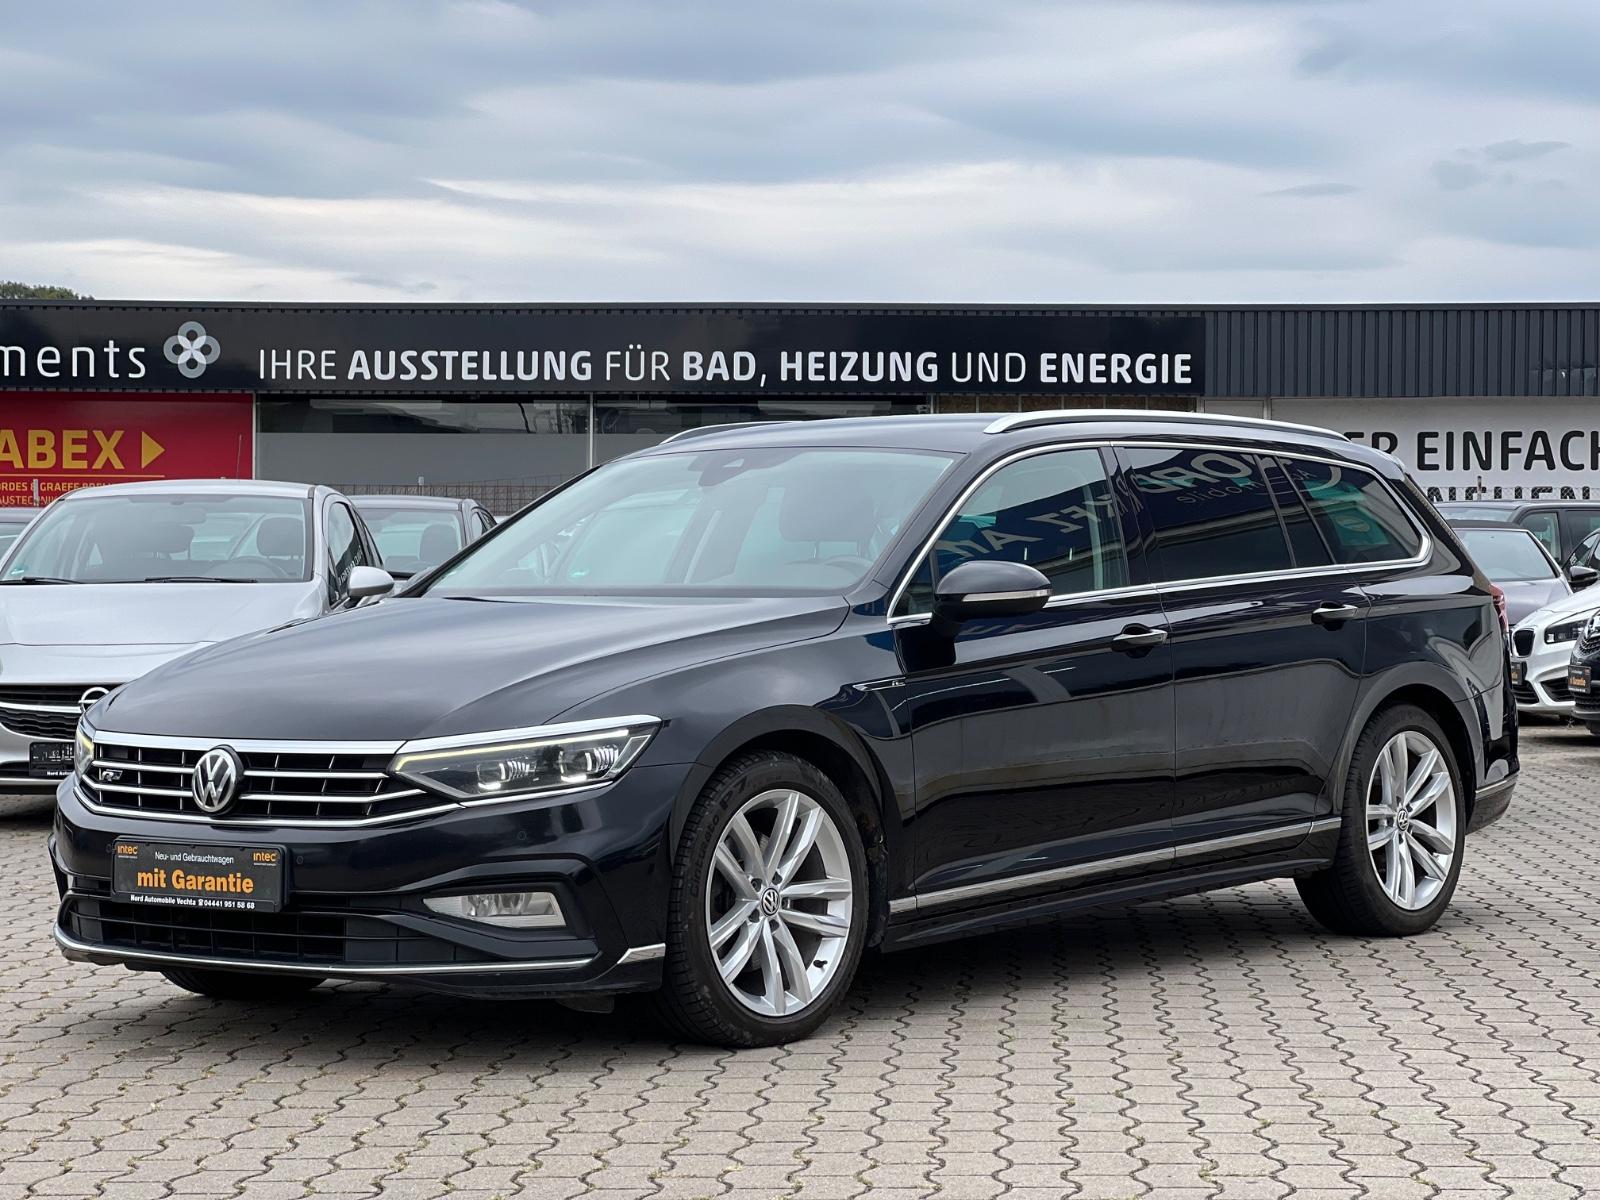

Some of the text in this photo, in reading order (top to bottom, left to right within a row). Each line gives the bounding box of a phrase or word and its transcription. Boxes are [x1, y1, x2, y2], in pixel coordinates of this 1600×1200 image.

[259, 344, 1192, 388] IHRE AUSSTELLUNG FÜR BAD, HEIZUNG UND ENERGIE
[0, 482, 28, 492] RDES
[154, 851, 235, 866] Neu- und Gebrauchtwagen
[137, 868, 254, 894] mit Garantie
